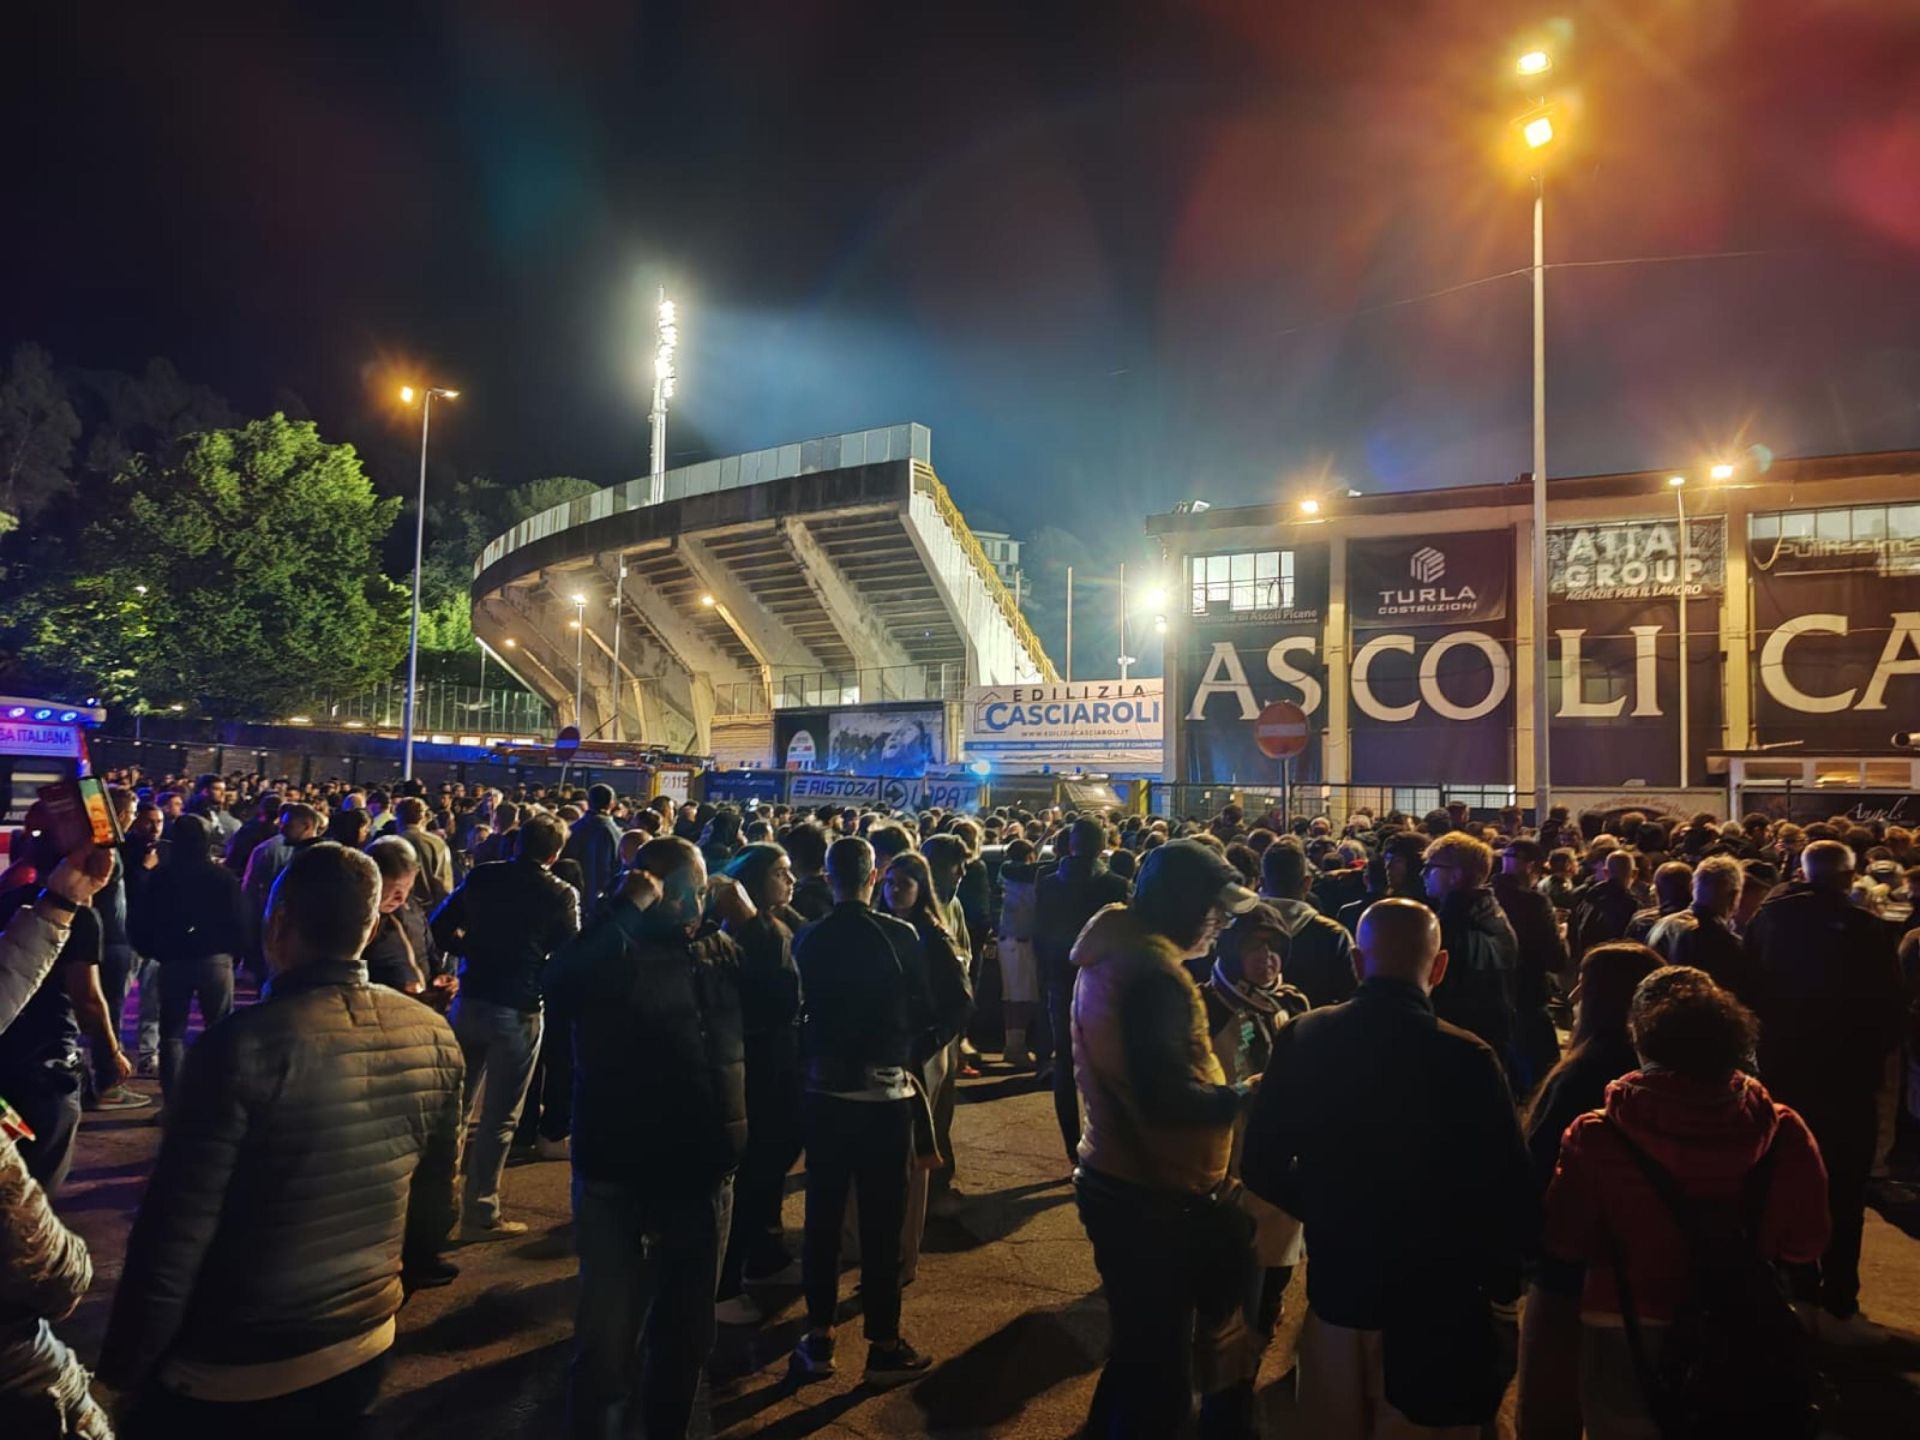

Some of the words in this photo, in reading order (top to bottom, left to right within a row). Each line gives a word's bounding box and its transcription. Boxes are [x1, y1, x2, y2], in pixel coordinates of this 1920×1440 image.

[1566, 523, 1700, 562] ATTAL
[1565, 558, 1703, 588] GROUP
[1378, 585, 1477, 605] TURLA
[1566, 588, 1612, 601] AGENZIE
[1614, 586, 1638, 598] PER
[1639, 585, 1650, 597] IL
[1652, 583, 1701, 597] LAVORO
[1378, 602, 1478, 615] COSTRUZIONI
[1185, 625, 1664, 721] ASCOLI
[1013, 685, 1146, 702] EDILIZIA
[985, 701, 1160, 731] CASCIAROLI
[17, 729, 72, 744] ITALIANA
